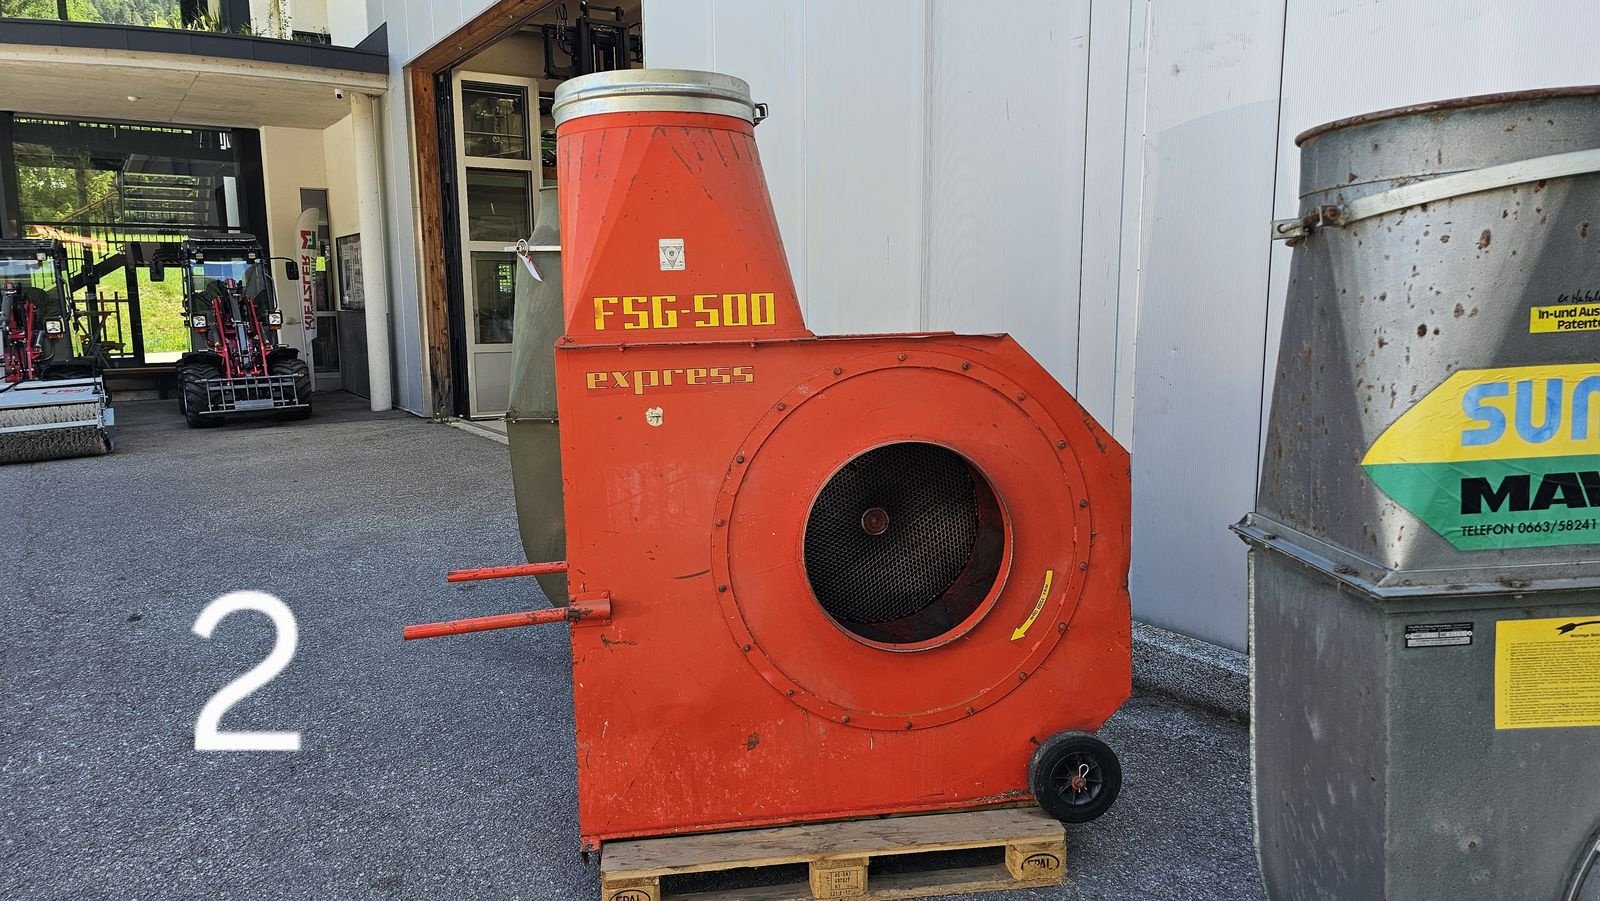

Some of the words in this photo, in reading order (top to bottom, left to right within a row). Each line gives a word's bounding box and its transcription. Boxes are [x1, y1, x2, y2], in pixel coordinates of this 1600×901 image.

[593, 292, 776, 331] FSG-500
[1538, 307, 1577, 319] In-und
[586, 366, 754, 395] express
[1460, 523, 1514, 536] TELEFON
[1518, 518, 1597, 533] 0663/58241
